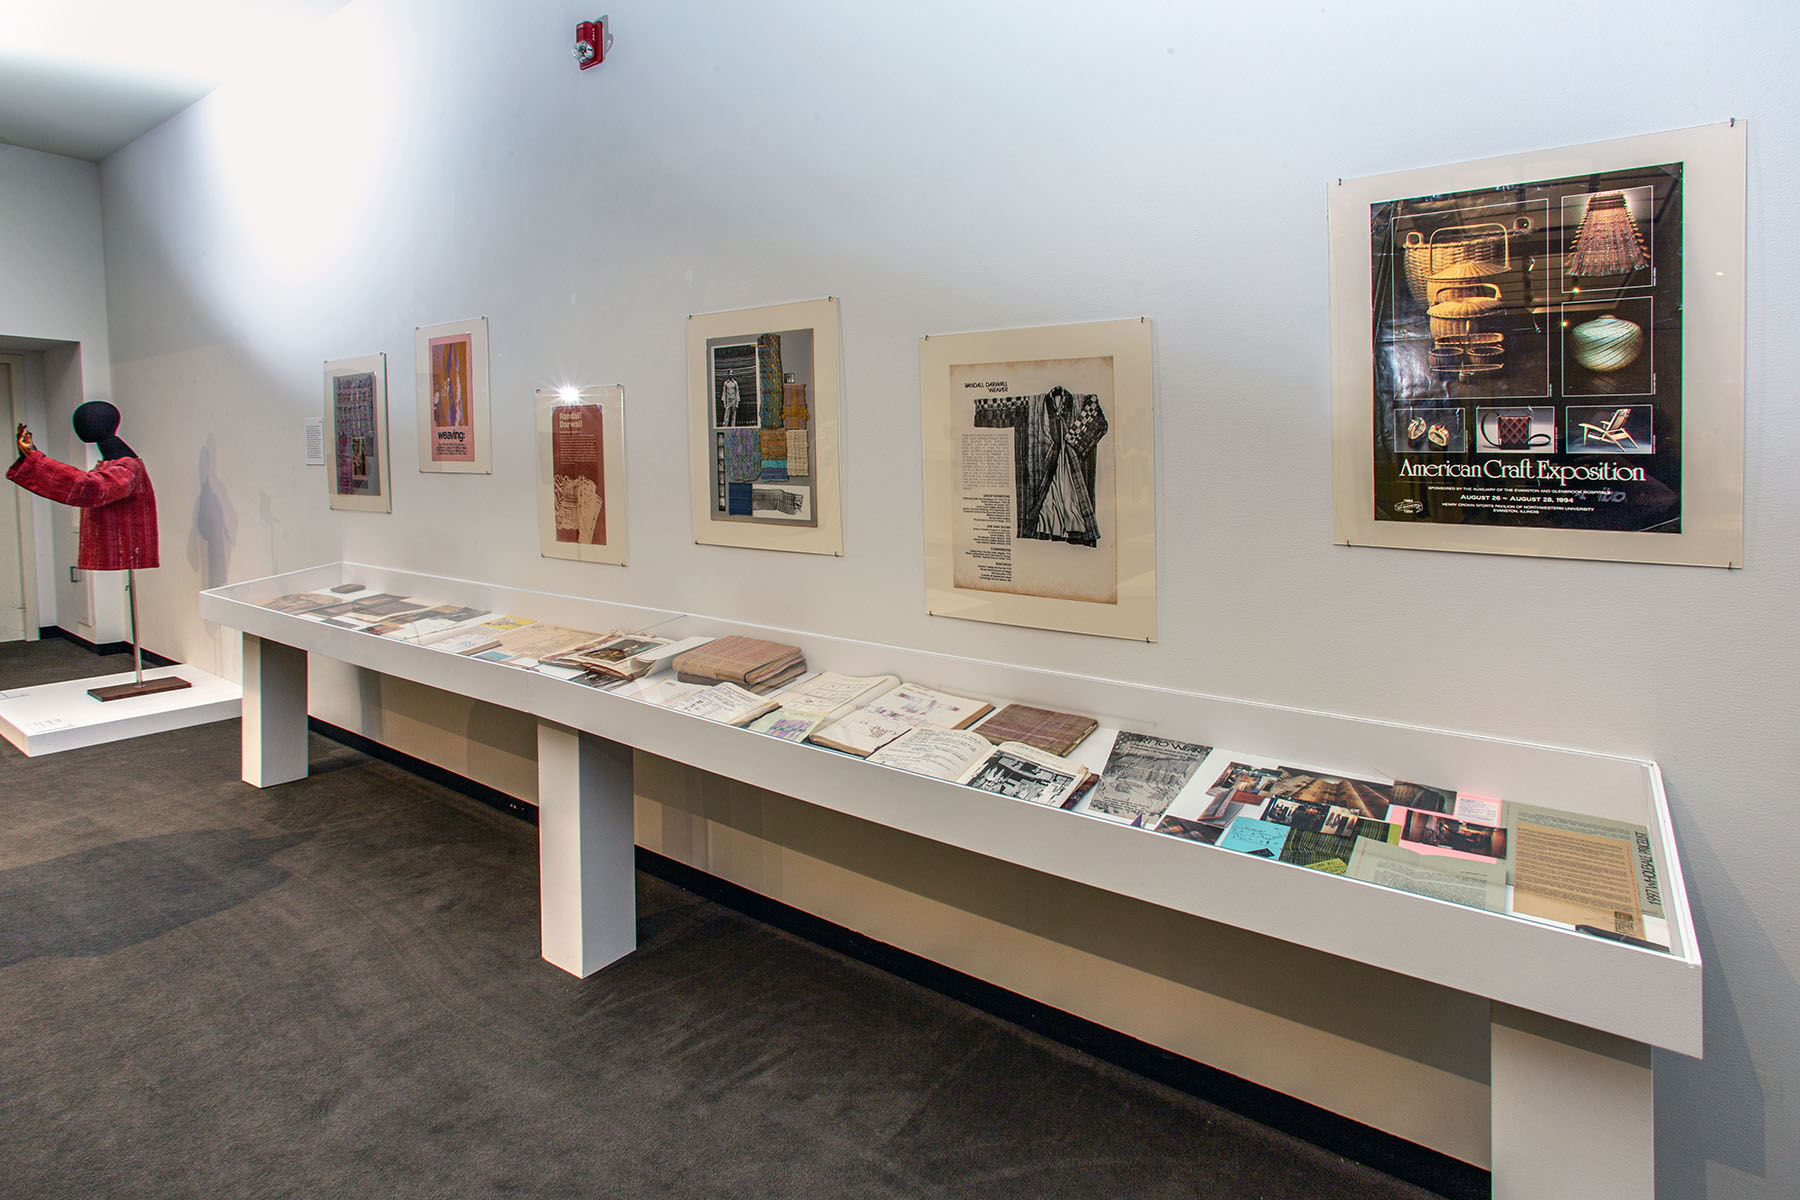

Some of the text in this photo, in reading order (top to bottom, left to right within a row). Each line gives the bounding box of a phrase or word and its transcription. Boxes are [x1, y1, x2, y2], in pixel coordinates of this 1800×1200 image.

[559, 420, 583, 428] Darwall
[1398, 458, 1647, 486] American Craft Exposition
[1645, 888, 1662, 906] 1997
